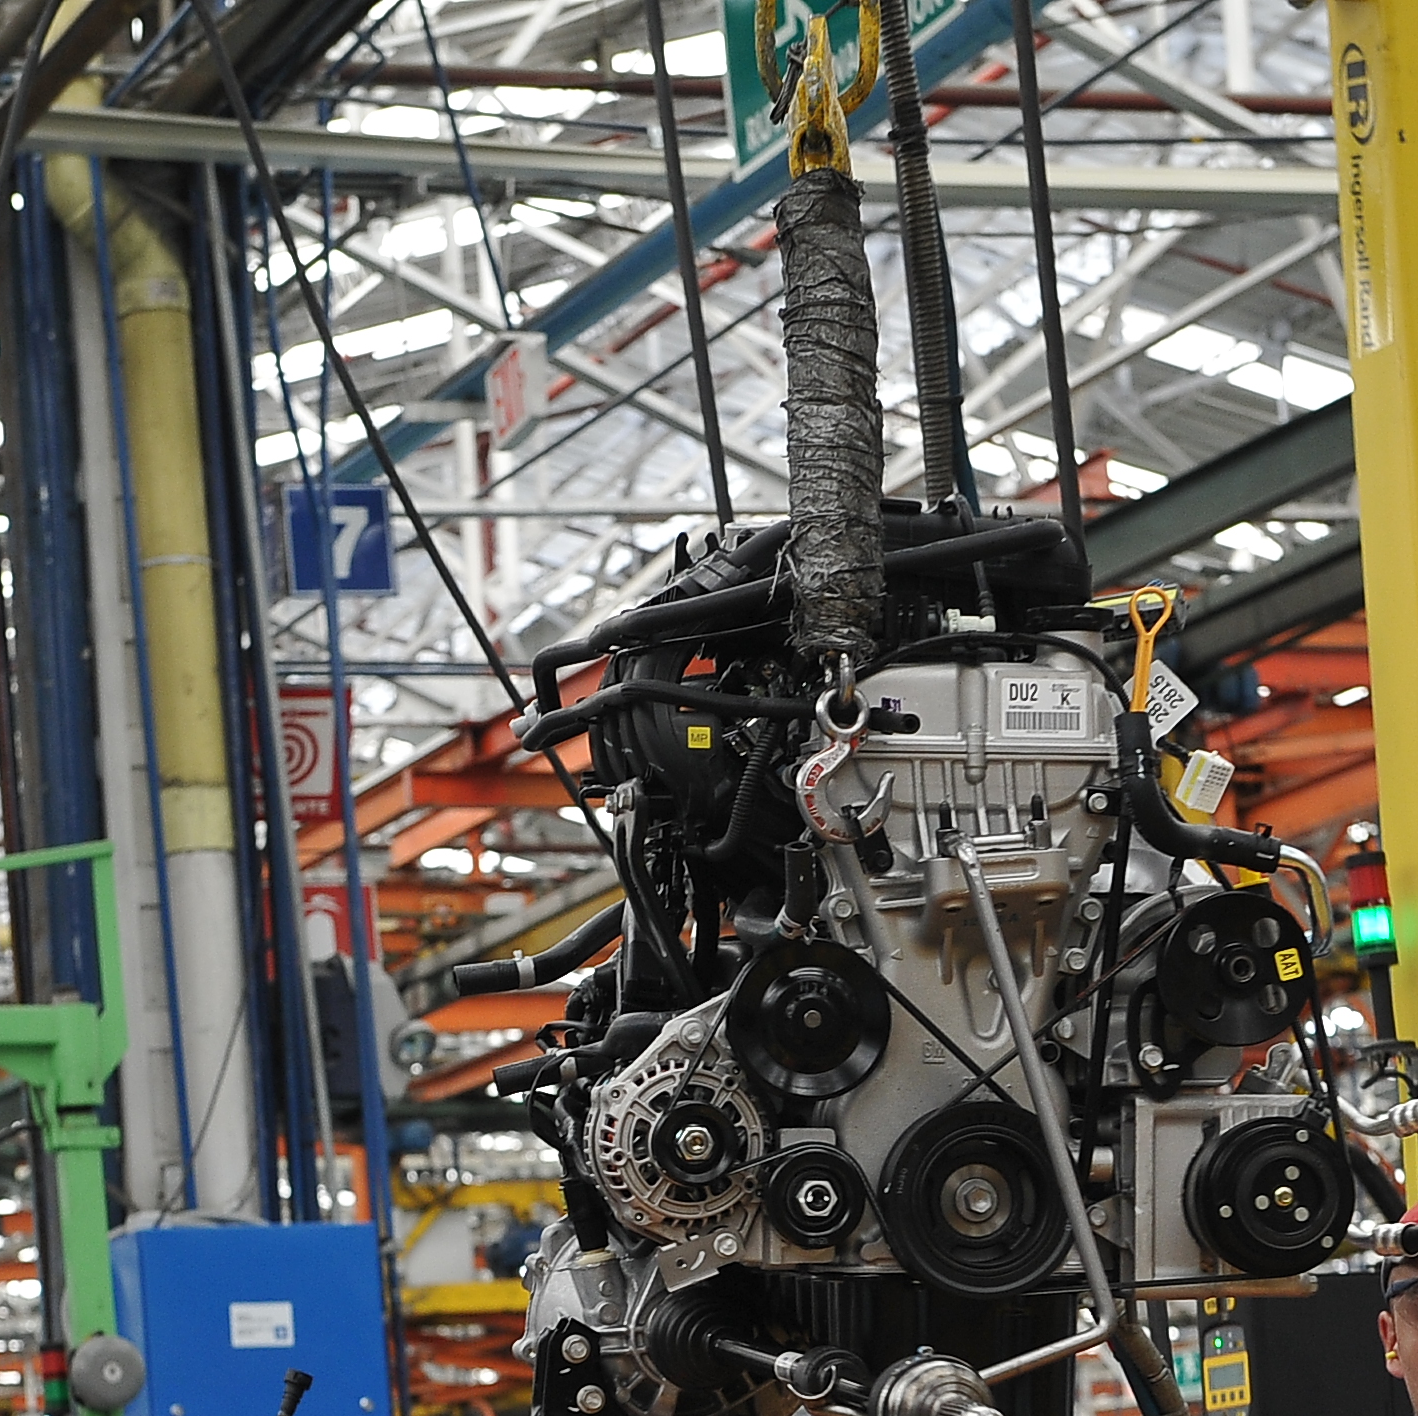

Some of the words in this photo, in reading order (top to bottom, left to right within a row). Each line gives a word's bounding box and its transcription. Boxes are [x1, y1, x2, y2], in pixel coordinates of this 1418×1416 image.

[1349, 154, 1371, 271] Ingersoll
[1359, 279, 1377, 350] Rand
[329, 505, 370, 580] 7
[1009, 682, 1039, 702] DU2
[1060, 692, 1071, 706] K
[1150, 675, 1186, 709] 2815
[1145, 695, 1170, 724] 281
[1278, 951, 1302, 979] AAT
